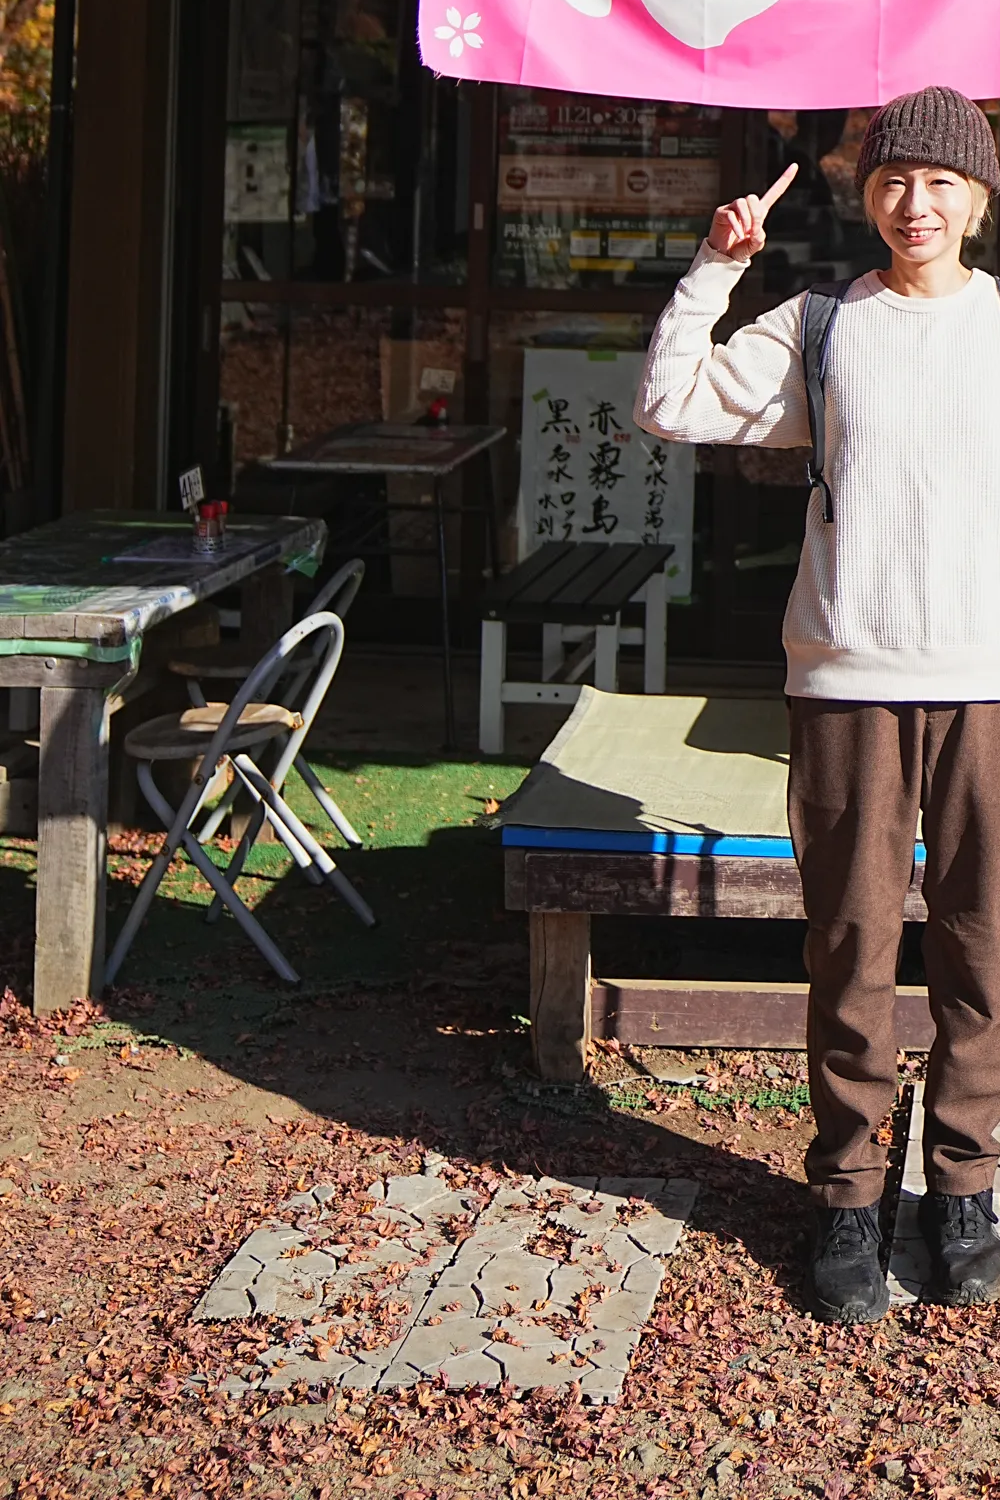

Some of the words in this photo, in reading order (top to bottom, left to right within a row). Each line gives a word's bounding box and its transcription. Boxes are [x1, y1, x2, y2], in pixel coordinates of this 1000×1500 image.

[557, 106, 591, 125] 11.21
[541, 399, 580, 435] 黒
[582, 400, 626, 535] 赤霧島
